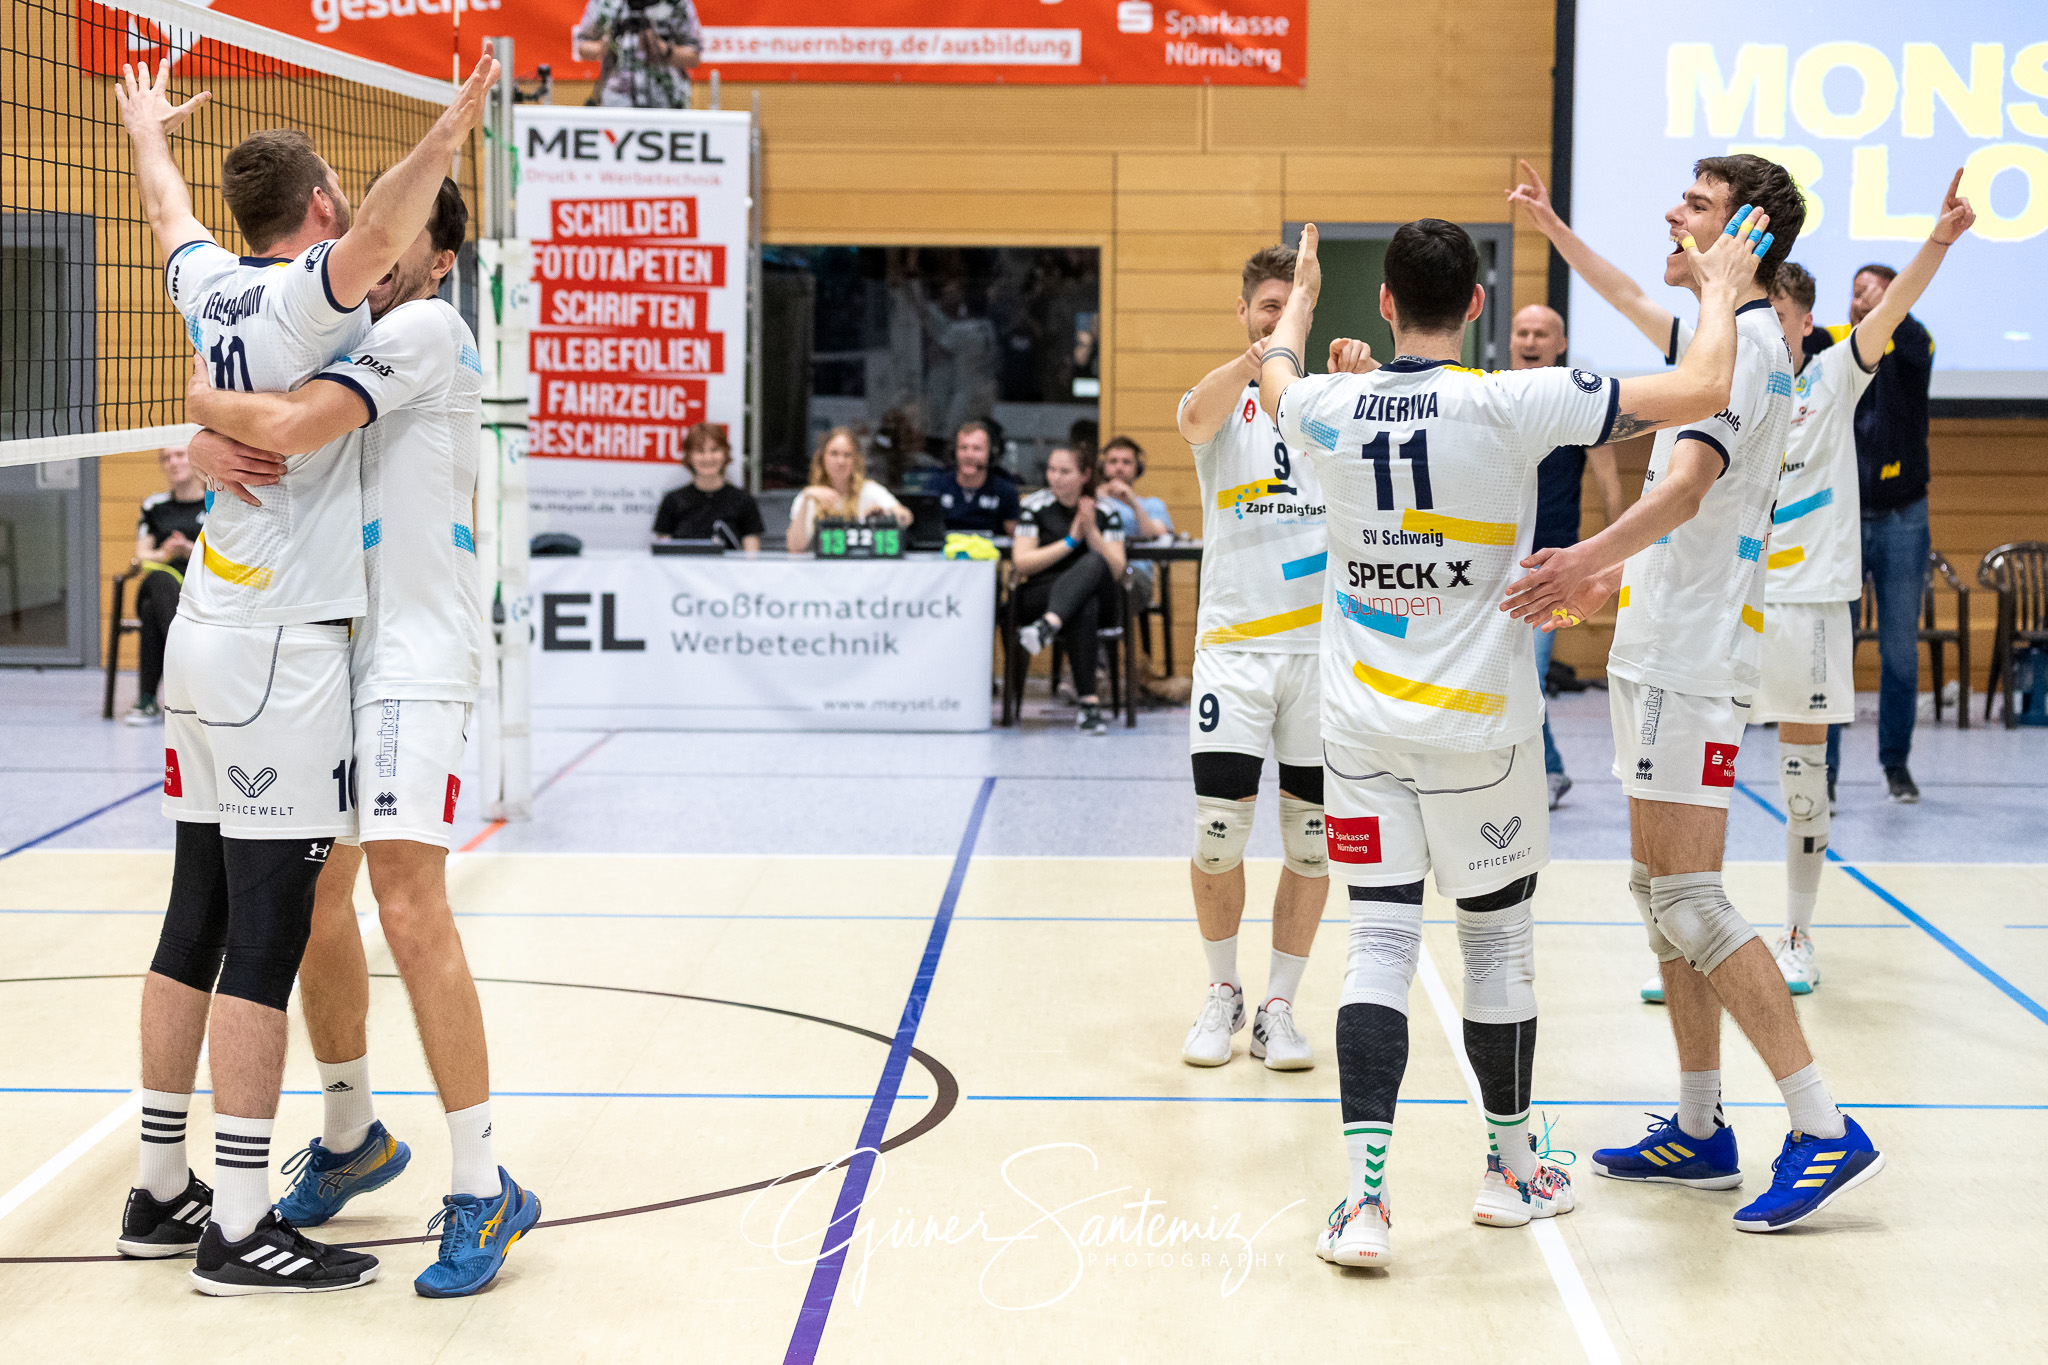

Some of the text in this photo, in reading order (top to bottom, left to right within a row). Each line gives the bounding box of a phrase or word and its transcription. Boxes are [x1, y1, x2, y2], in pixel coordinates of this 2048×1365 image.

[1165, 9, 1290, 39] Sparkasse
[701, 33, 1073, 59] asse-nuernberg.de/ausbildung
[1165, 41, 1282, 73] Nürnberg
[527, 127, 724, 164] MEYSEL
[556, 201, 689, 237] SCHILDER
[531, 245, 713, 283] FOTOTAPETEN
[550, 290, 697, 330] SCHRIFTEN
[533, 336, 712, 373] KLEBEFOLIEN
[547, 380, 702, 420] FAHRZEUG-
[528, 419, 690, 460] BESCHRIFTU
[1274, 442, 1291, 481] 9
[1362, 428, 1434, 511] 11
[1246, 502, 1275, 515] Zapf
[821, 528, 846, 555] 13
[875, 529, 900, 555] 15
[1363, 528, 1444, 547] SV Schwaig
[1348, 560, 1440, 590] SPECK
[671, 592, 963, 620] Großformatdruck
[1346, 594, 1442, 623] pumpen
[671, 631, 900, 657] Werbetechnik
[822, 697, 961, 715] www.meysel.de
[1199, 693, 1220, 733] 9
[219, 803, 294, 816] OFFICEWELT
[1335, 830, 1370, 842] Sparkasse
[1337, 843, 1368, 855] Nürnberg
[1469, 847, 1532, 871] OFFICEWELT
